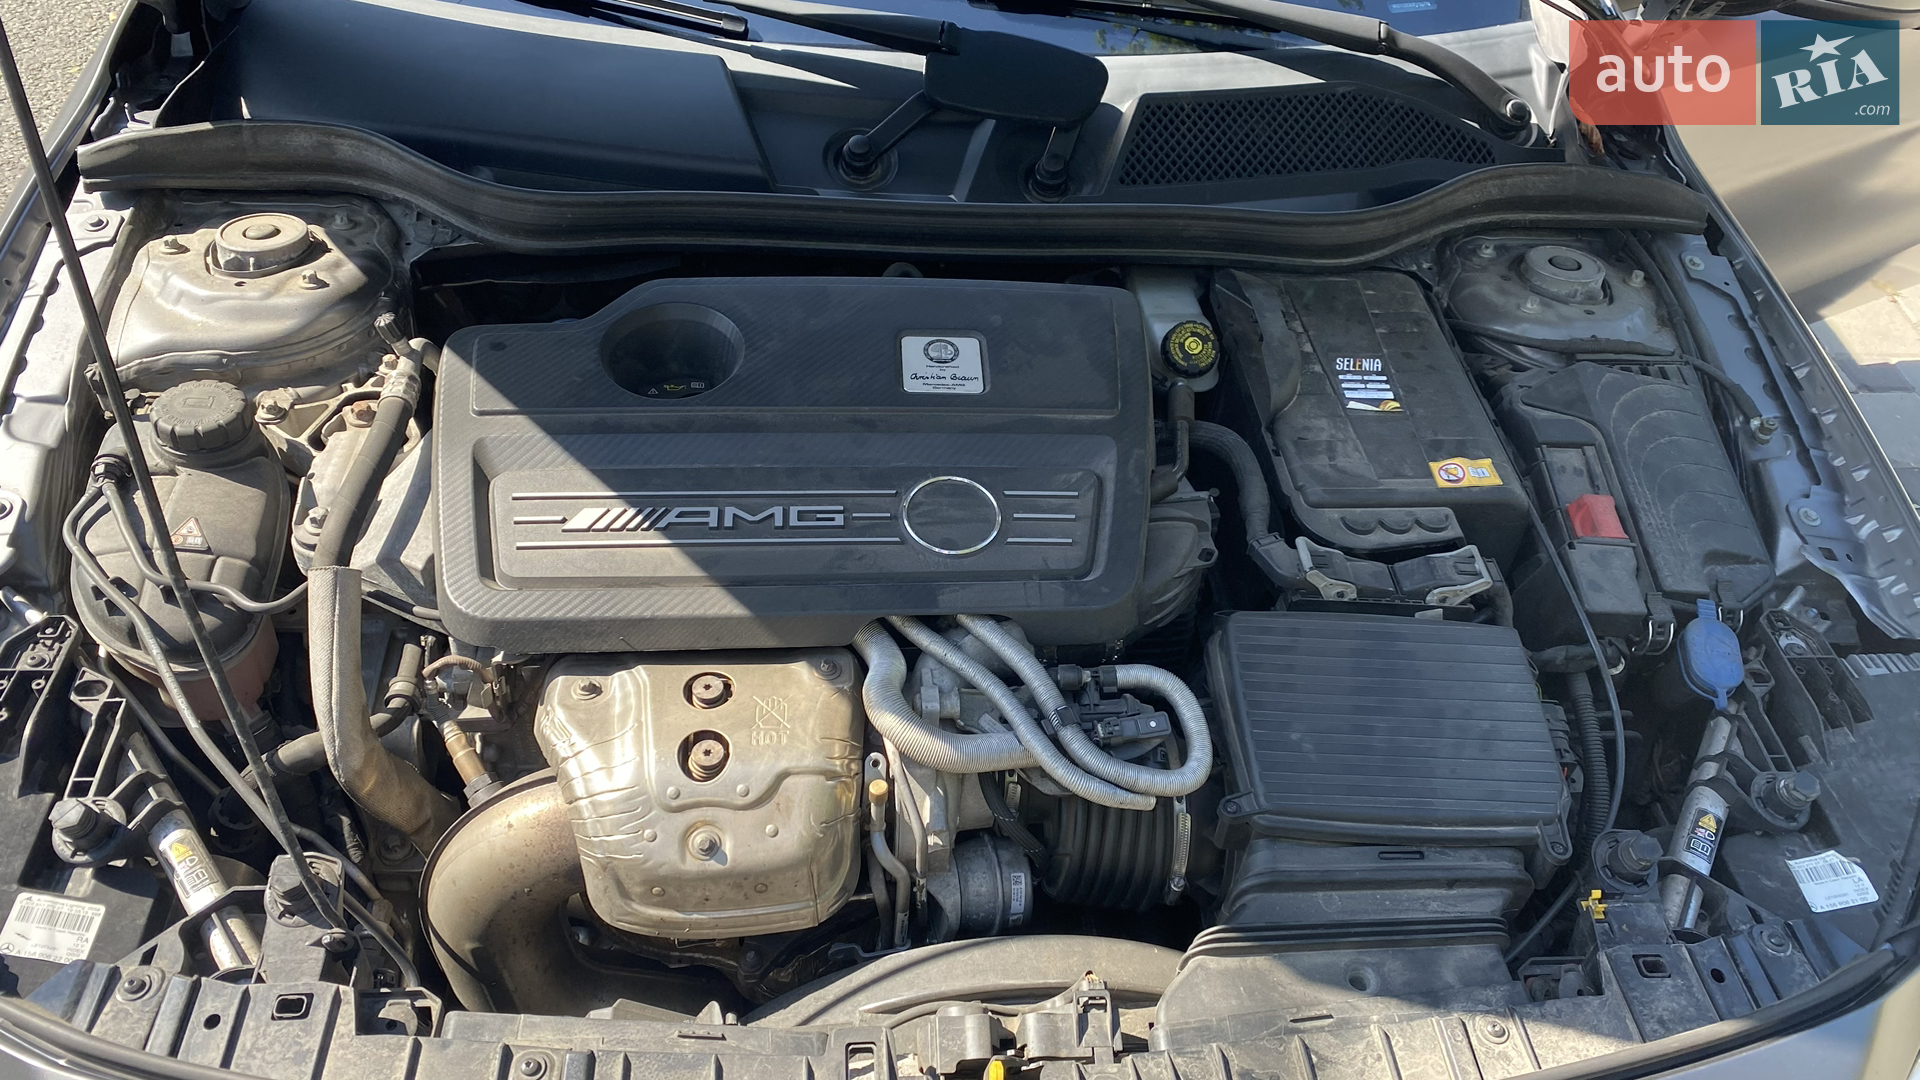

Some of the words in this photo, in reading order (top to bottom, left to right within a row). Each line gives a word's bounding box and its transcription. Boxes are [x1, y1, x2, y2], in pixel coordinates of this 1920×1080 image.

[1336, 357, 1382, 371] SELENIA
[653, 506, 844, 530] AMG
[751, 731, 789, 746] HOT
[76, 936, 89, 944] RA
